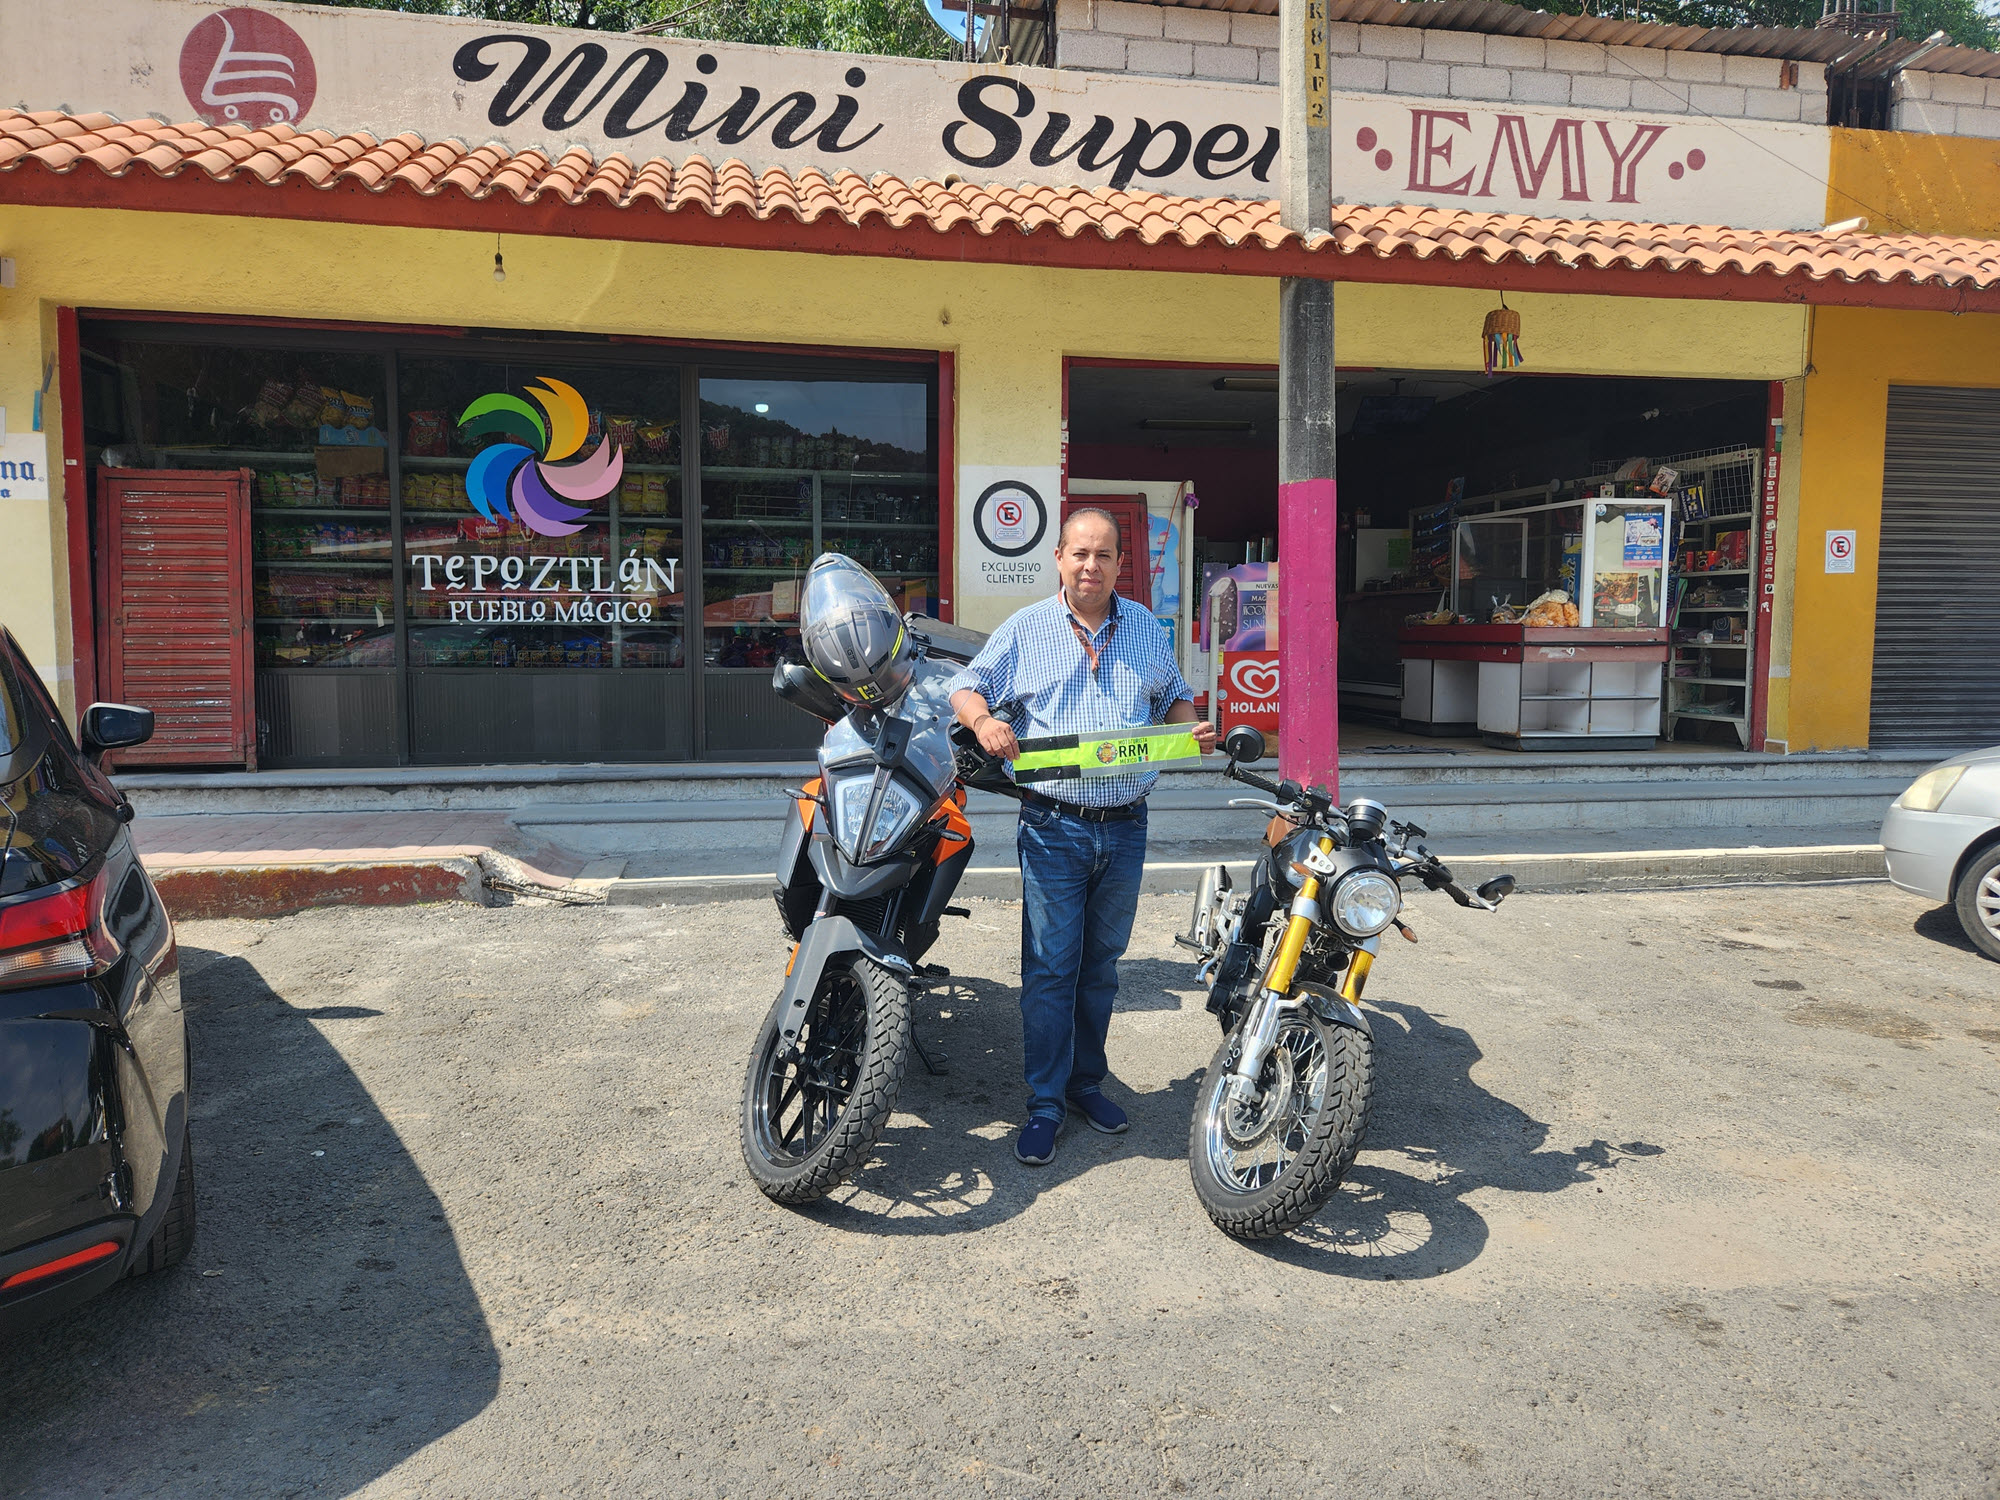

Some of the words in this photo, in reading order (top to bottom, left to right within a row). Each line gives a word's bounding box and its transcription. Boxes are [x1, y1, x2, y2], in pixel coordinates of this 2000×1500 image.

[452, 34, 884, 153] Mini
[1405, 109, 1671, 203] EMY
[981, 561, 1042, 572] EXCLUSIVO
[986, 574, 1035, 584] CLIENTES
[1119, 743, 1148, 757] RRM
